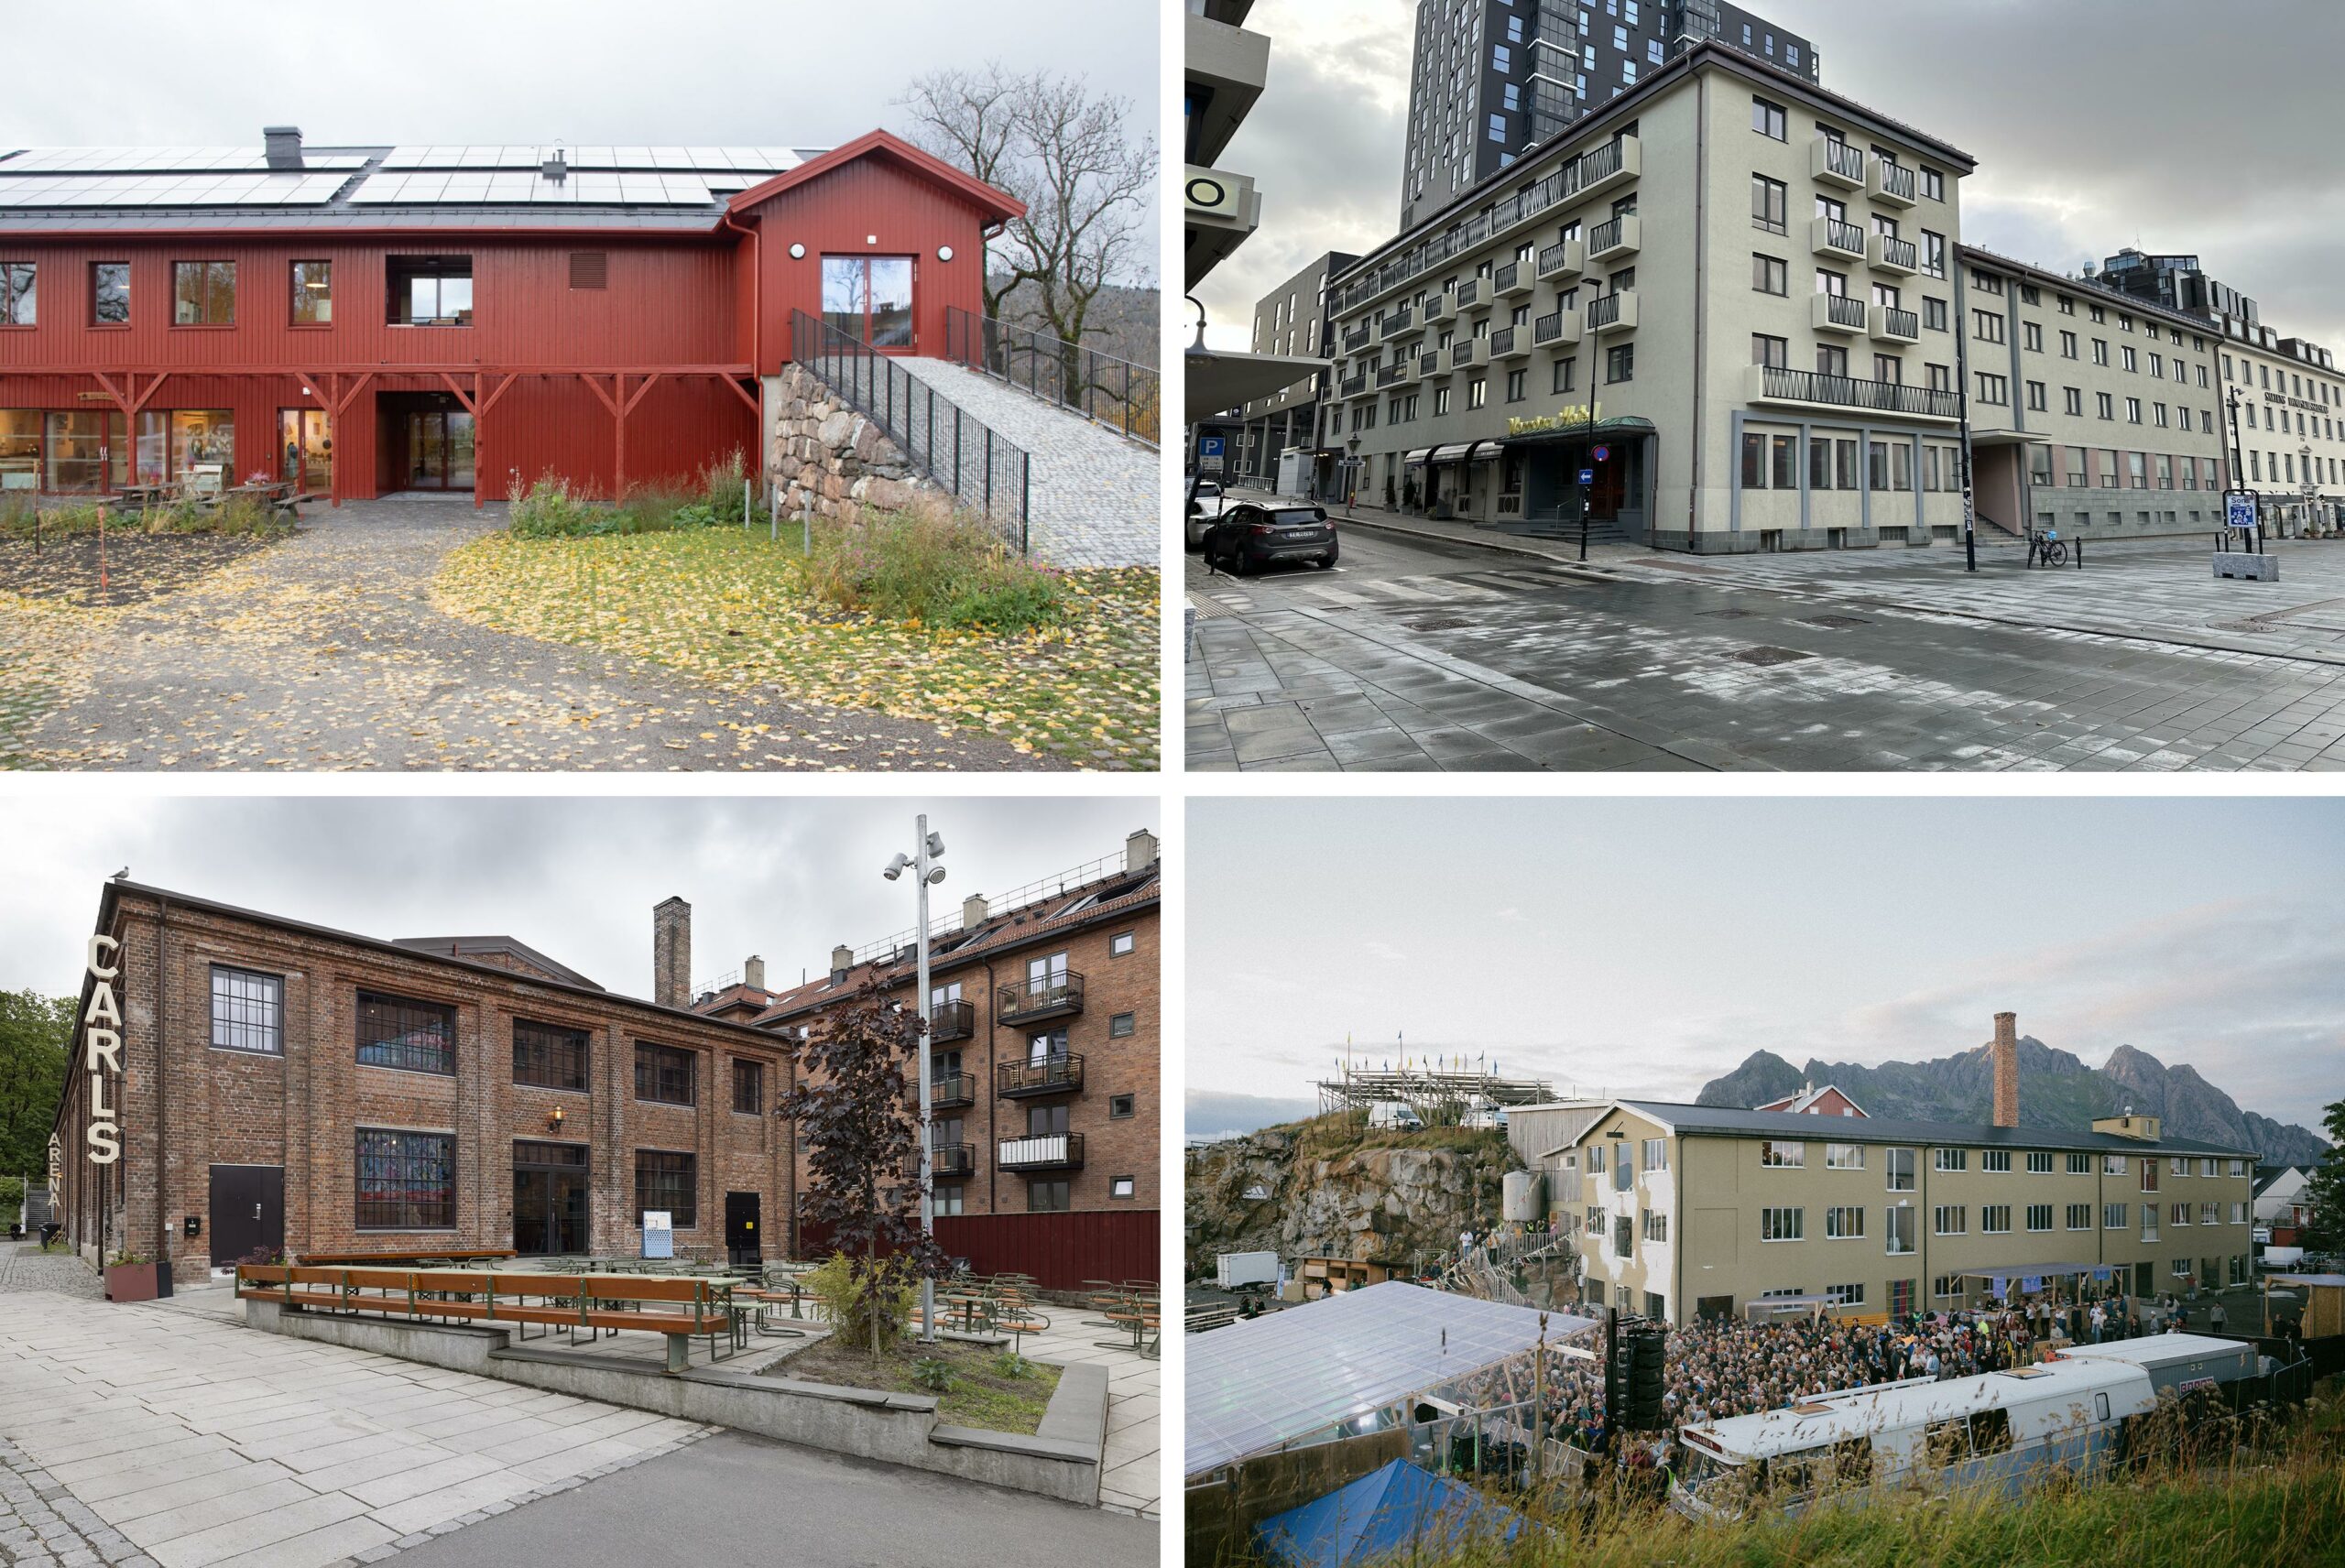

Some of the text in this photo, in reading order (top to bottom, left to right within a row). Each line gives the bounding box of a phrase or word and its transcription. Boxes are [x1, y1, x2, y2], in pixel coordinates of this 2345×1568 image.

[1205, 440, 1218, 454] P
[84, 933, 122, 1164] CARLS
[48, 1132, 61, 1207] ARENA
